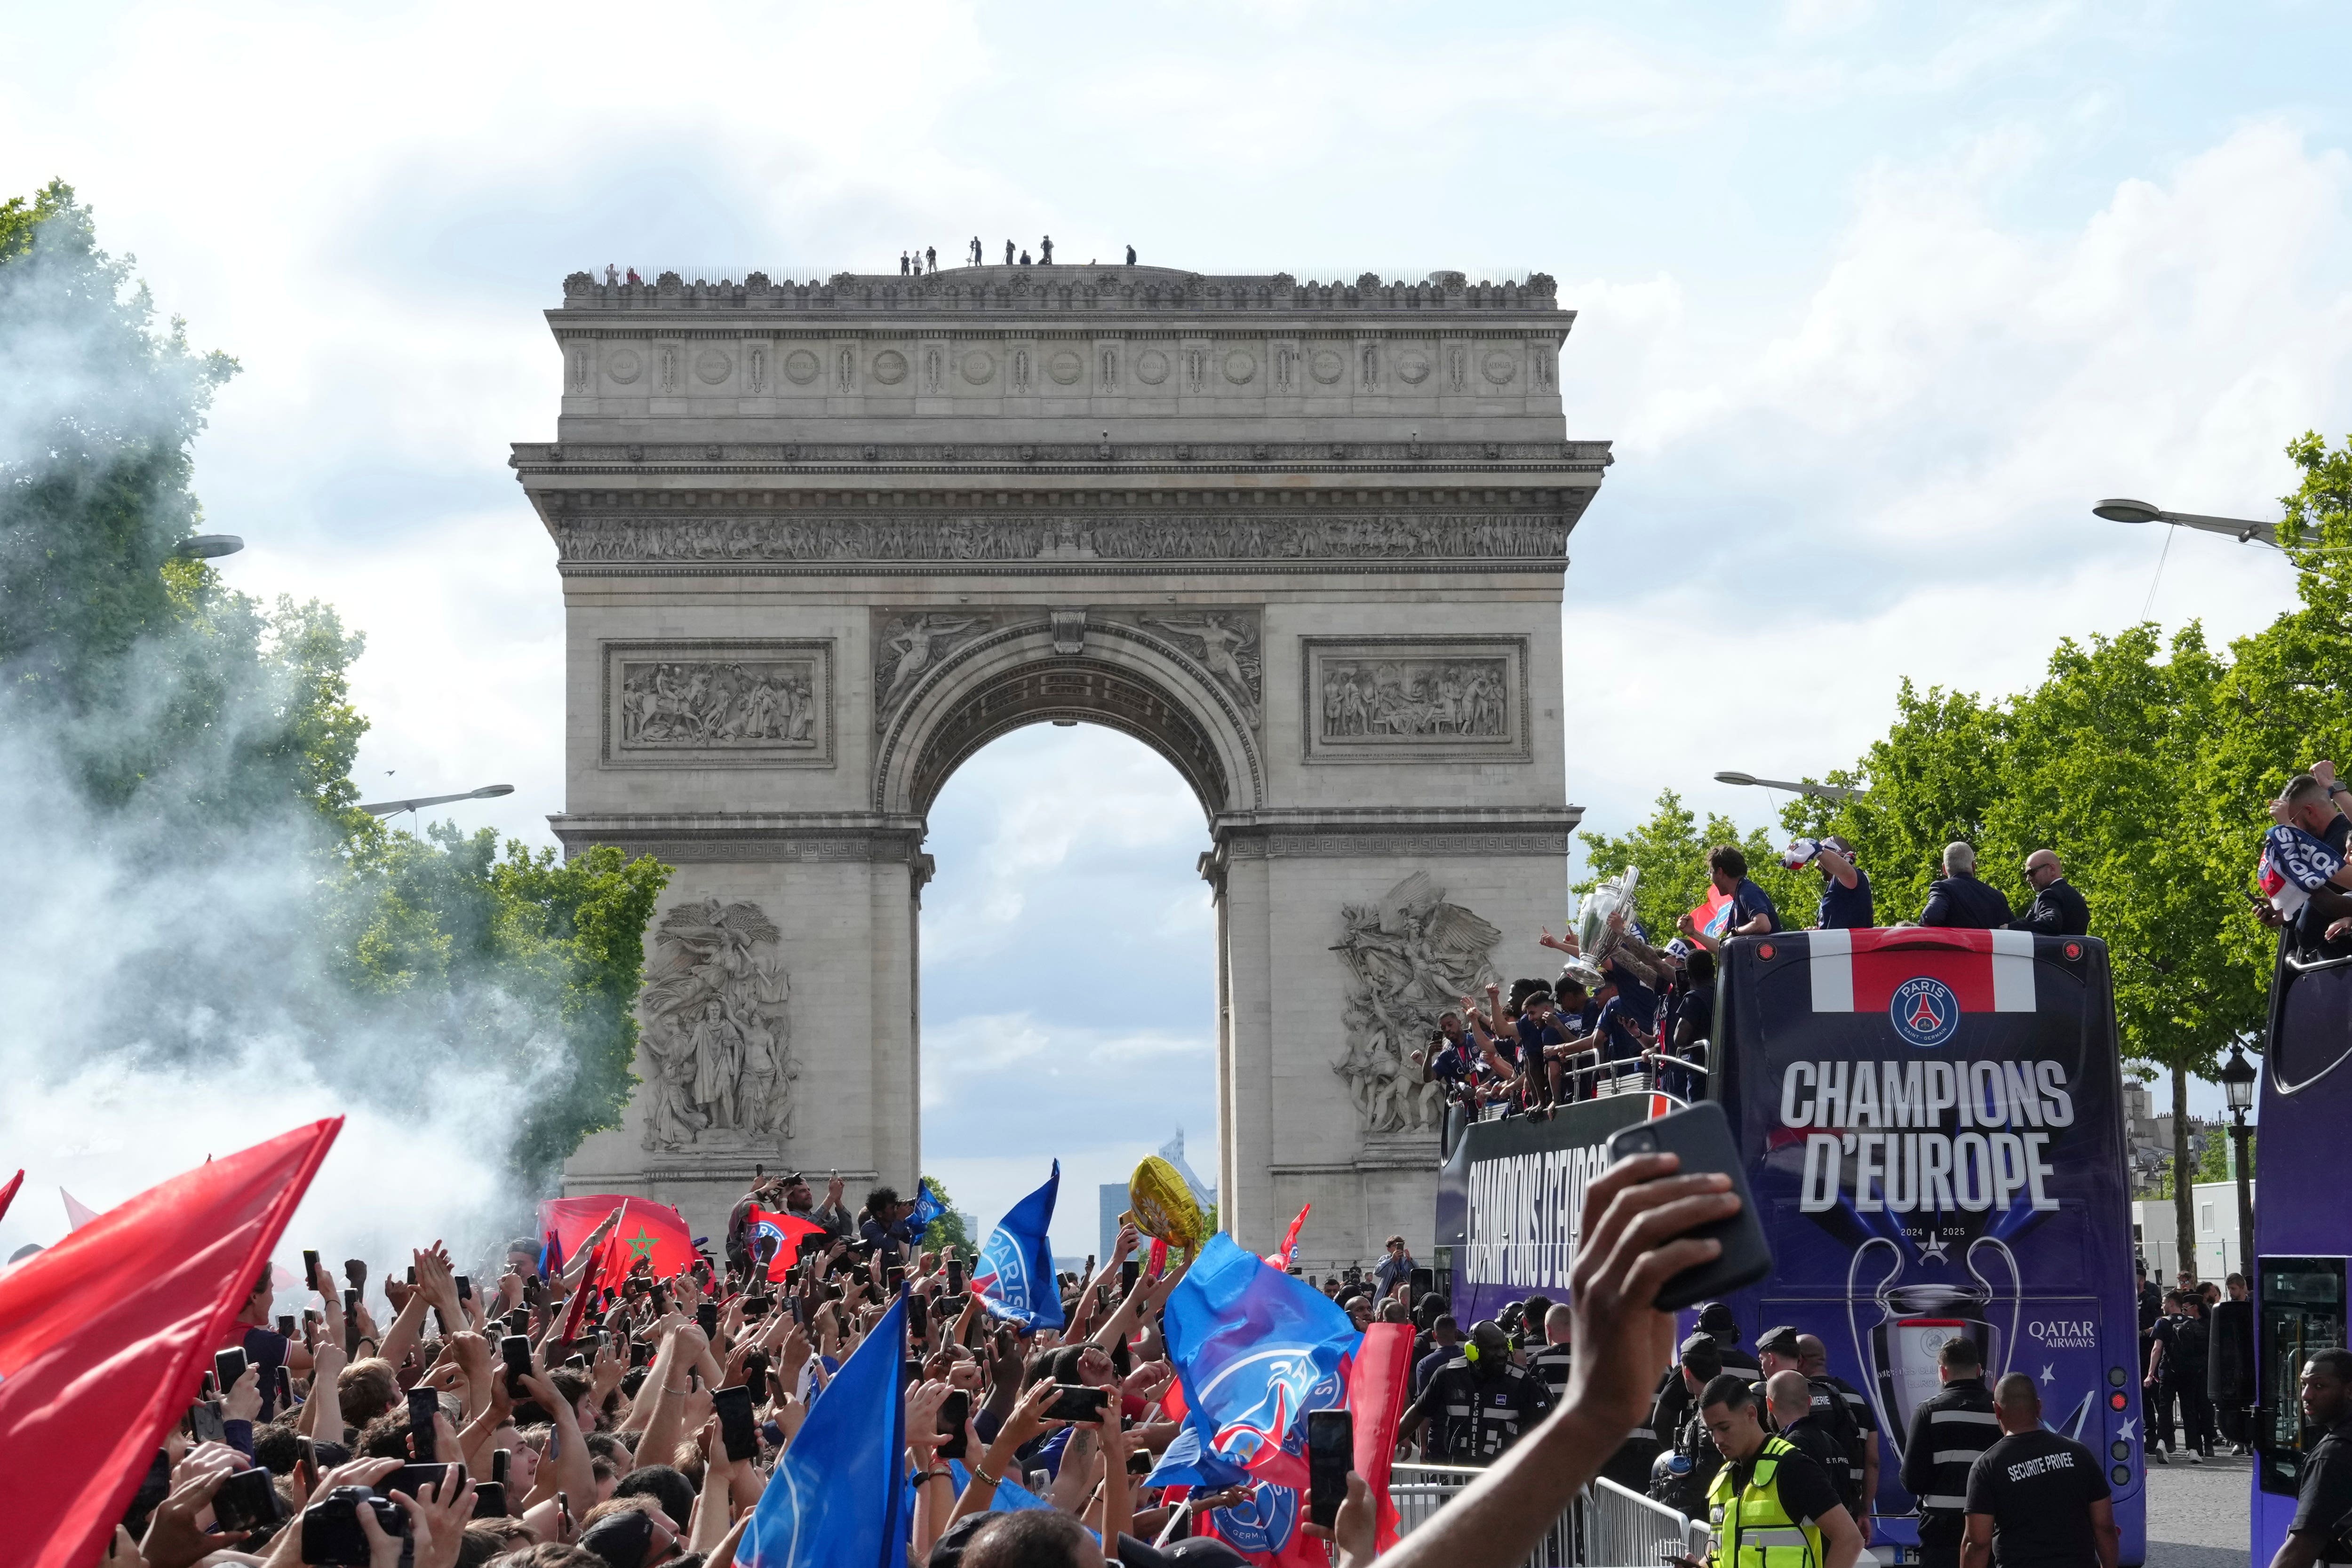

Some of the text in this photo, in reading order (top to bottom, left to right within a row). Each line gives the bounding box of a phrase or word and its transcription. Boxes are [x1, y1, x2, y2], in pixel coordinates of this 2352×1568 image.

[1901, 981, 1945, 998] PARIS
[1923, 1027, 1947, 1041] GERMAIN
[1780, 1060, 2074, 1128] CHAMPIONS
[1799, 1132, 2060, 1212] D'EUROPE
[1466, 1151, 1542, 1289] CHAMPIONS
[2028, 1321, 2095, 1341] QATAR
[2046, 1338, 2095, 1348] AIRWAYS
[2007, 1452, 2074, 1482] SECURITE PRIVEE
